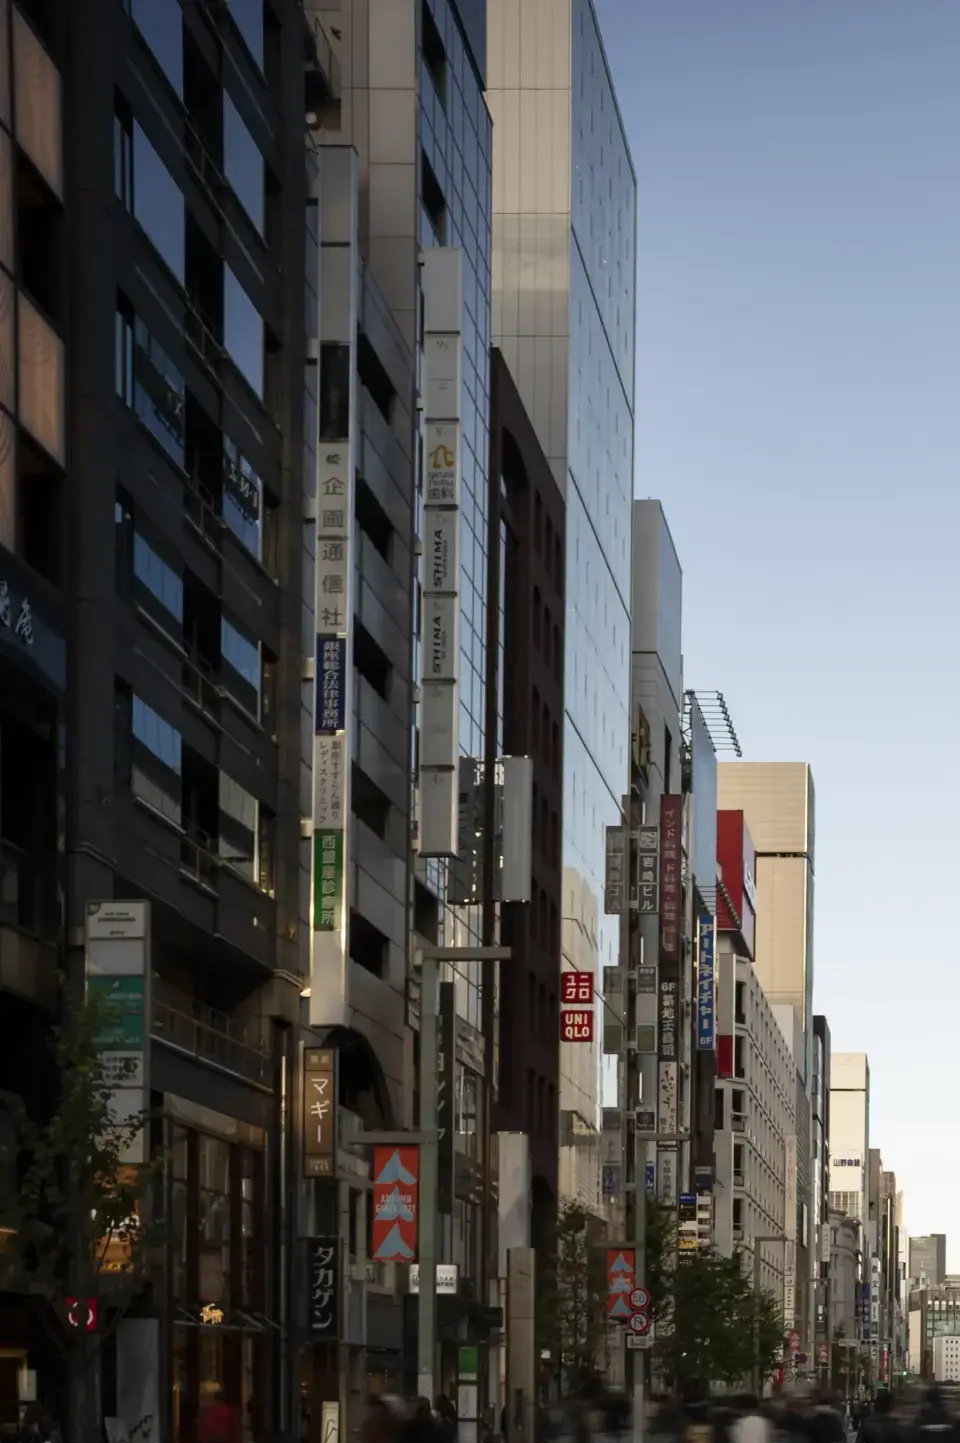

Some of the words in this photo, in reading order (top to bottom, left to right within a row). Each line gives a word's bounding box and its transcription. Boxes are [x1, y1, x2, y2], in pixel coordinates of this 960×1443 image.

[321, 476, 345, 627] 企画通信社
[434, 530, 442, 588] SHIMA
[433, 616, 441, 673] SHIMA
[661, 982, 676, 991] 6F
[565, 1014, 589, 1025] UNI
[565, 1026, 590, 1040] QLO
[310, 1078, 330, 1145] マギー
[313, 1245, 334, 1330] タカゲン
